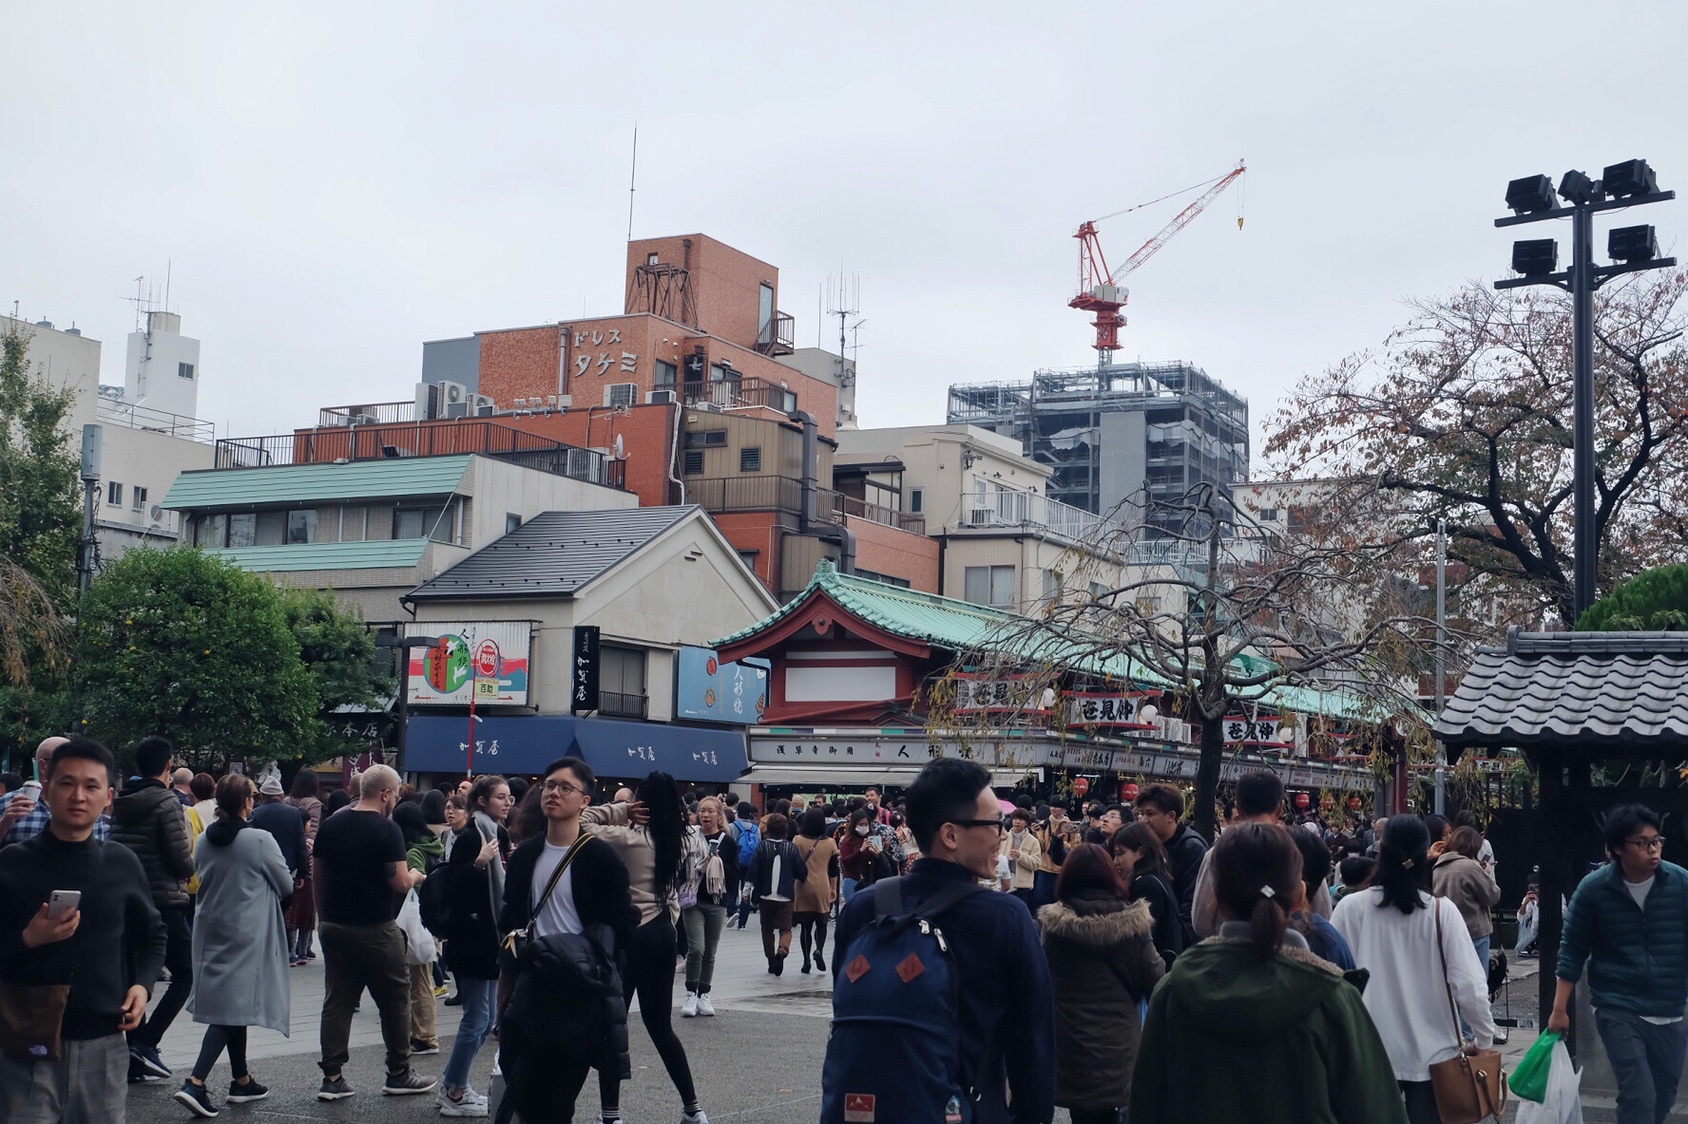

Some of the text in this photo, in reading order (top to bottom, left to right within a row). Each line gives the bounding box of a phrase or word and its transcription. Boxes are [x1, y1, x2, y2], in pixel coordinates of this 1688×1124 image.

[574, 329, 622, 348] ドレス
[575, 351, 638, 378] タケミ
[480, 653, 496, 665] 消火栓
[576, 656, 590, 701] 加賀屋
[480, 683, 494, 694] 百助
